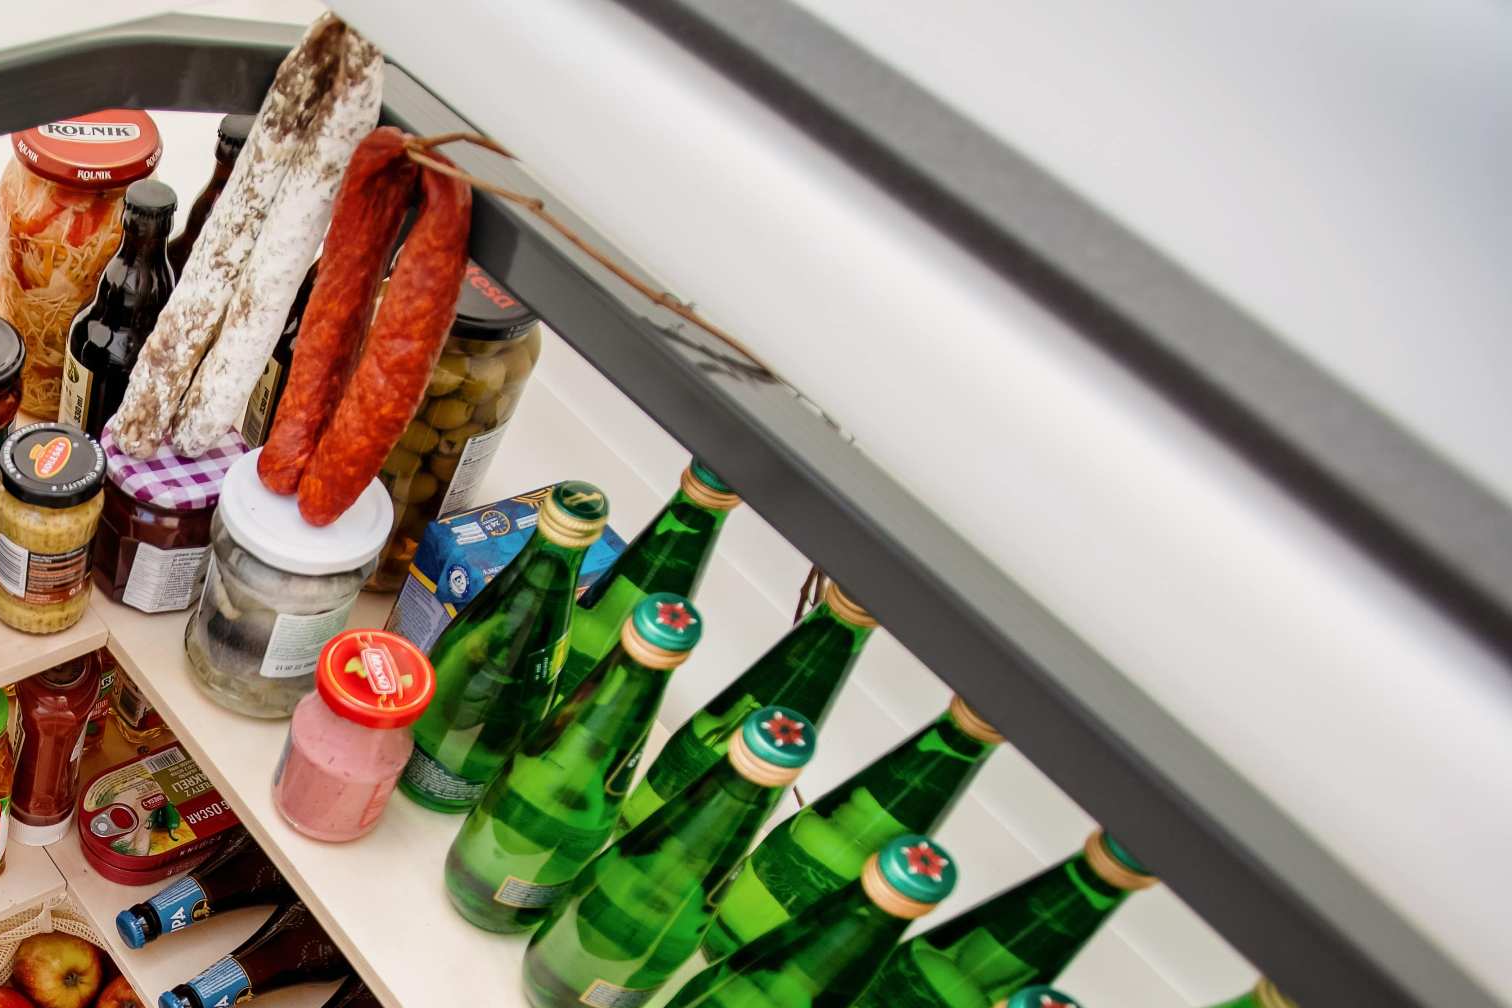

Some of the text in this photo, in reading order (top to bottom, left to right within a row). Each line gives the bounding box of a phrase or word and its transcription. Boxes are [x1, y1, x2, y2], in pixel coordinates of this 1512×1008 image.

[47, 124, 131, 138] ROLNIK
[17, 139, 39, 164] ROLNIK
[77, 168, 112, 181] ROLNIK
[172, 772, 209, 793] AKRELI
[187, 803, 224, 825] OSCAR
